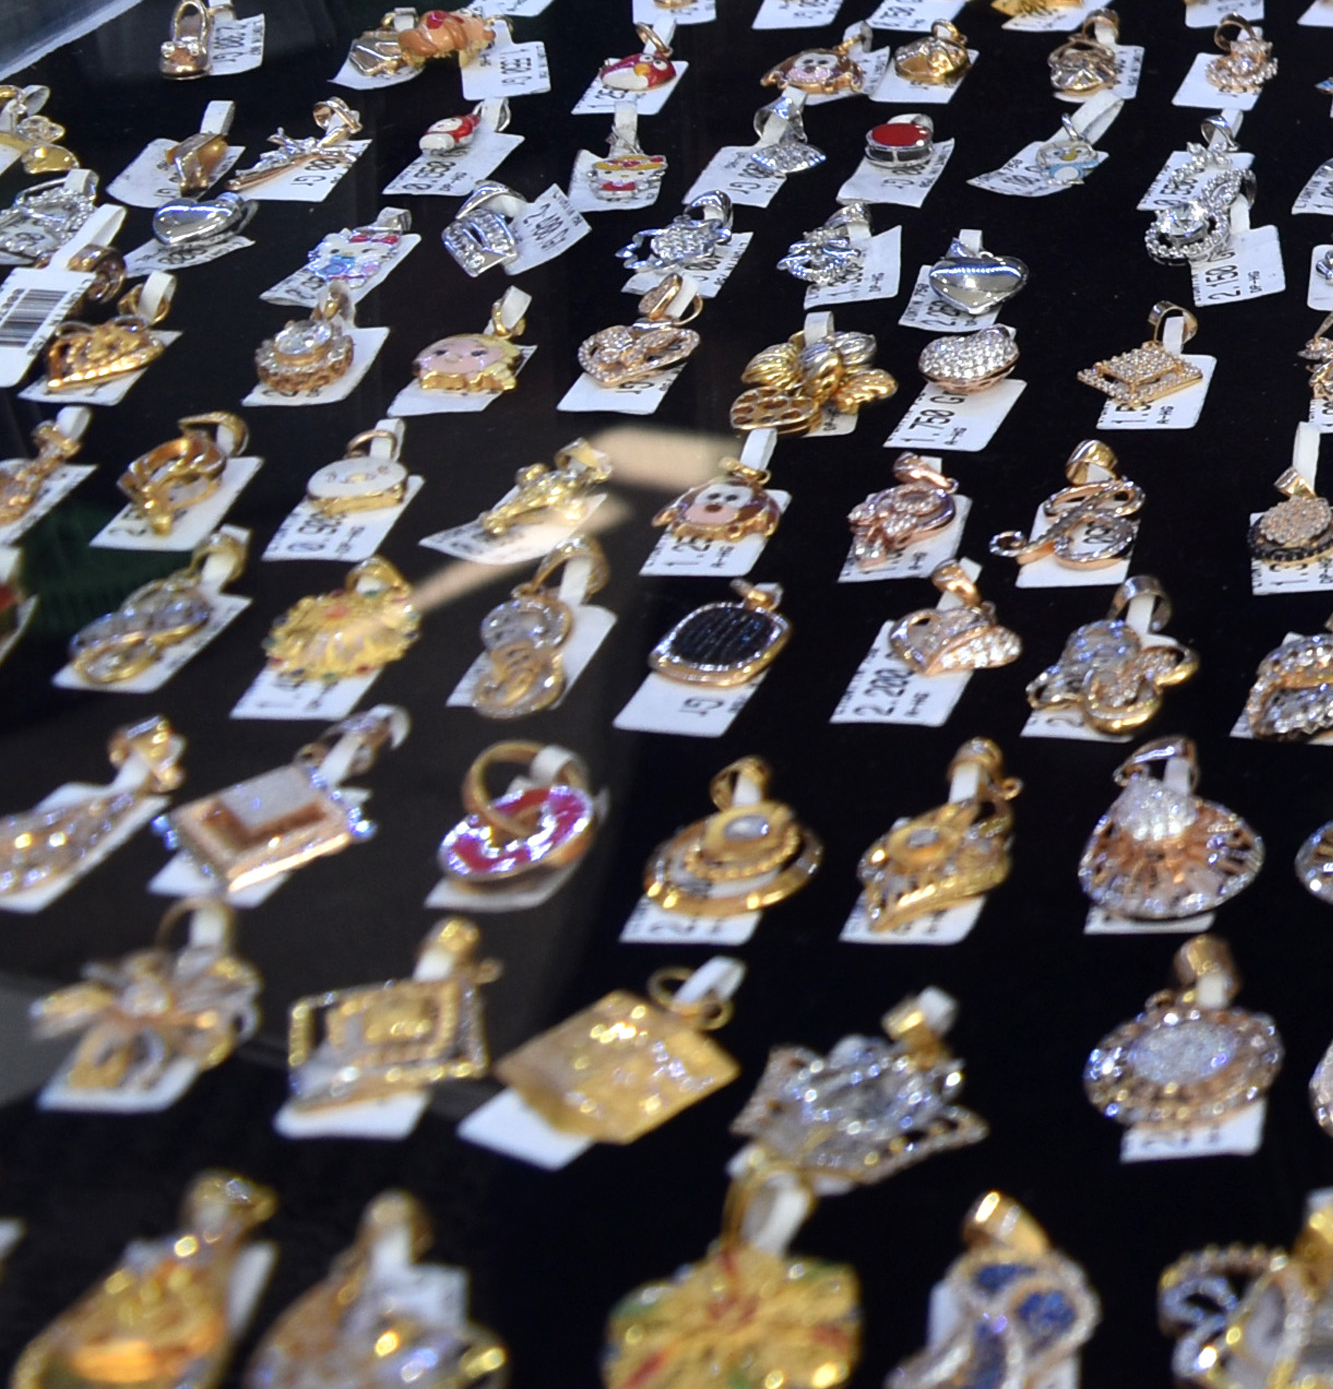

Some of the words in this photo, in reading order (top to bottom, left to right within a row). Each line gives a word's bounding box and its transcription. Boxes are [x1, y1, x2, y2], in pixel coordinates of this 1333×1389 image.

[1205, 265, 1240, 299] 2.150
[1250, 270, 1262, 293] DP-HG
[1156, 405, 1174, 424] A-HG
[904, 412, 955, 443] 1.750
[945, 426, 967, 445] A-HG
